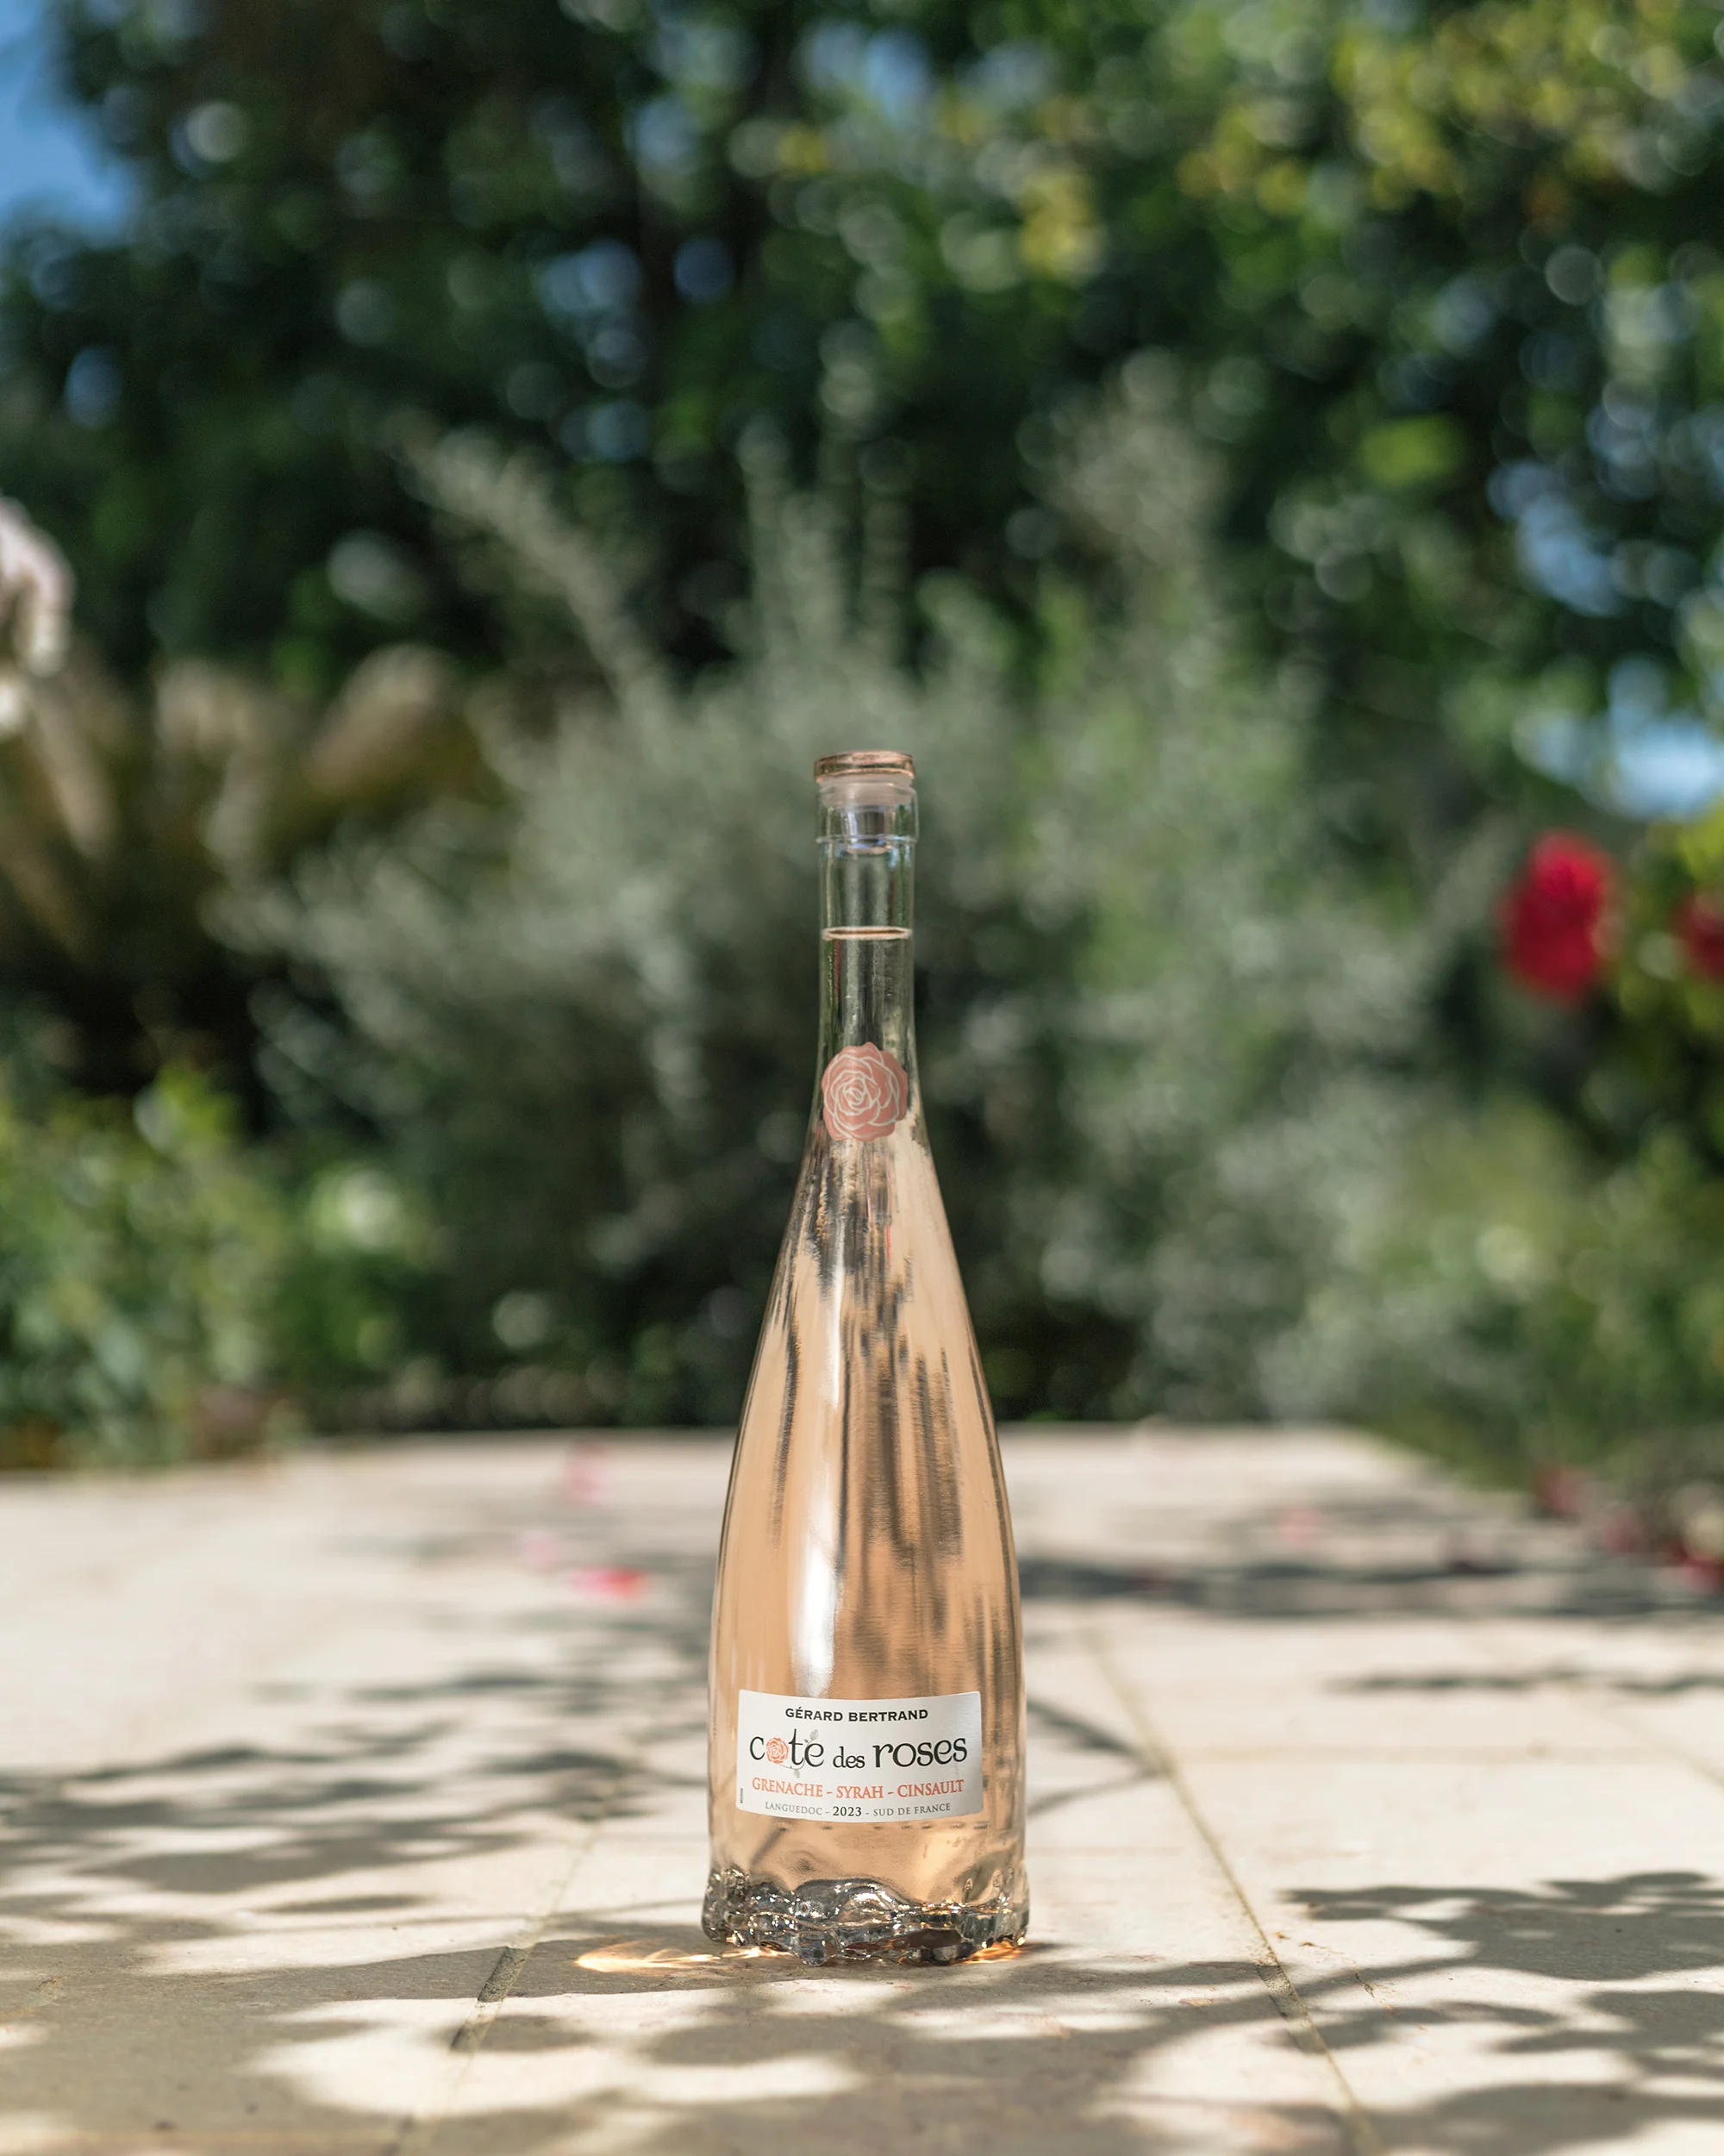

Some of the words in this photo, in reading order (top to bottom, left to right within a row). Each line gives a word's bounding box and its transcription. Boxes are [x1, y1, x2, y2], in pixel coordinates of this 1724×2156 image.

[785, 1707, 843, 1722] GÉRARD
[848, 1708, 928, 1722] BERTRAND
[833, 1746, 865, 1769] des
[872, 1737, 968, 1768] roses
[752, 1777, 823, 1797] GRENACHE
[836, 1785, 884, 1799] SYRAH
[896, 1779, 965, 1798] CINSAULT
[765, 1801, 823, 1816] LANGUEDOC
[833, 1805, 862, 1817] 2023
[873, 1808, 894, 1816] SUD
[897, 1807, 911, 1815] DE
[914, 1803, 951, 1814] FRANCE
